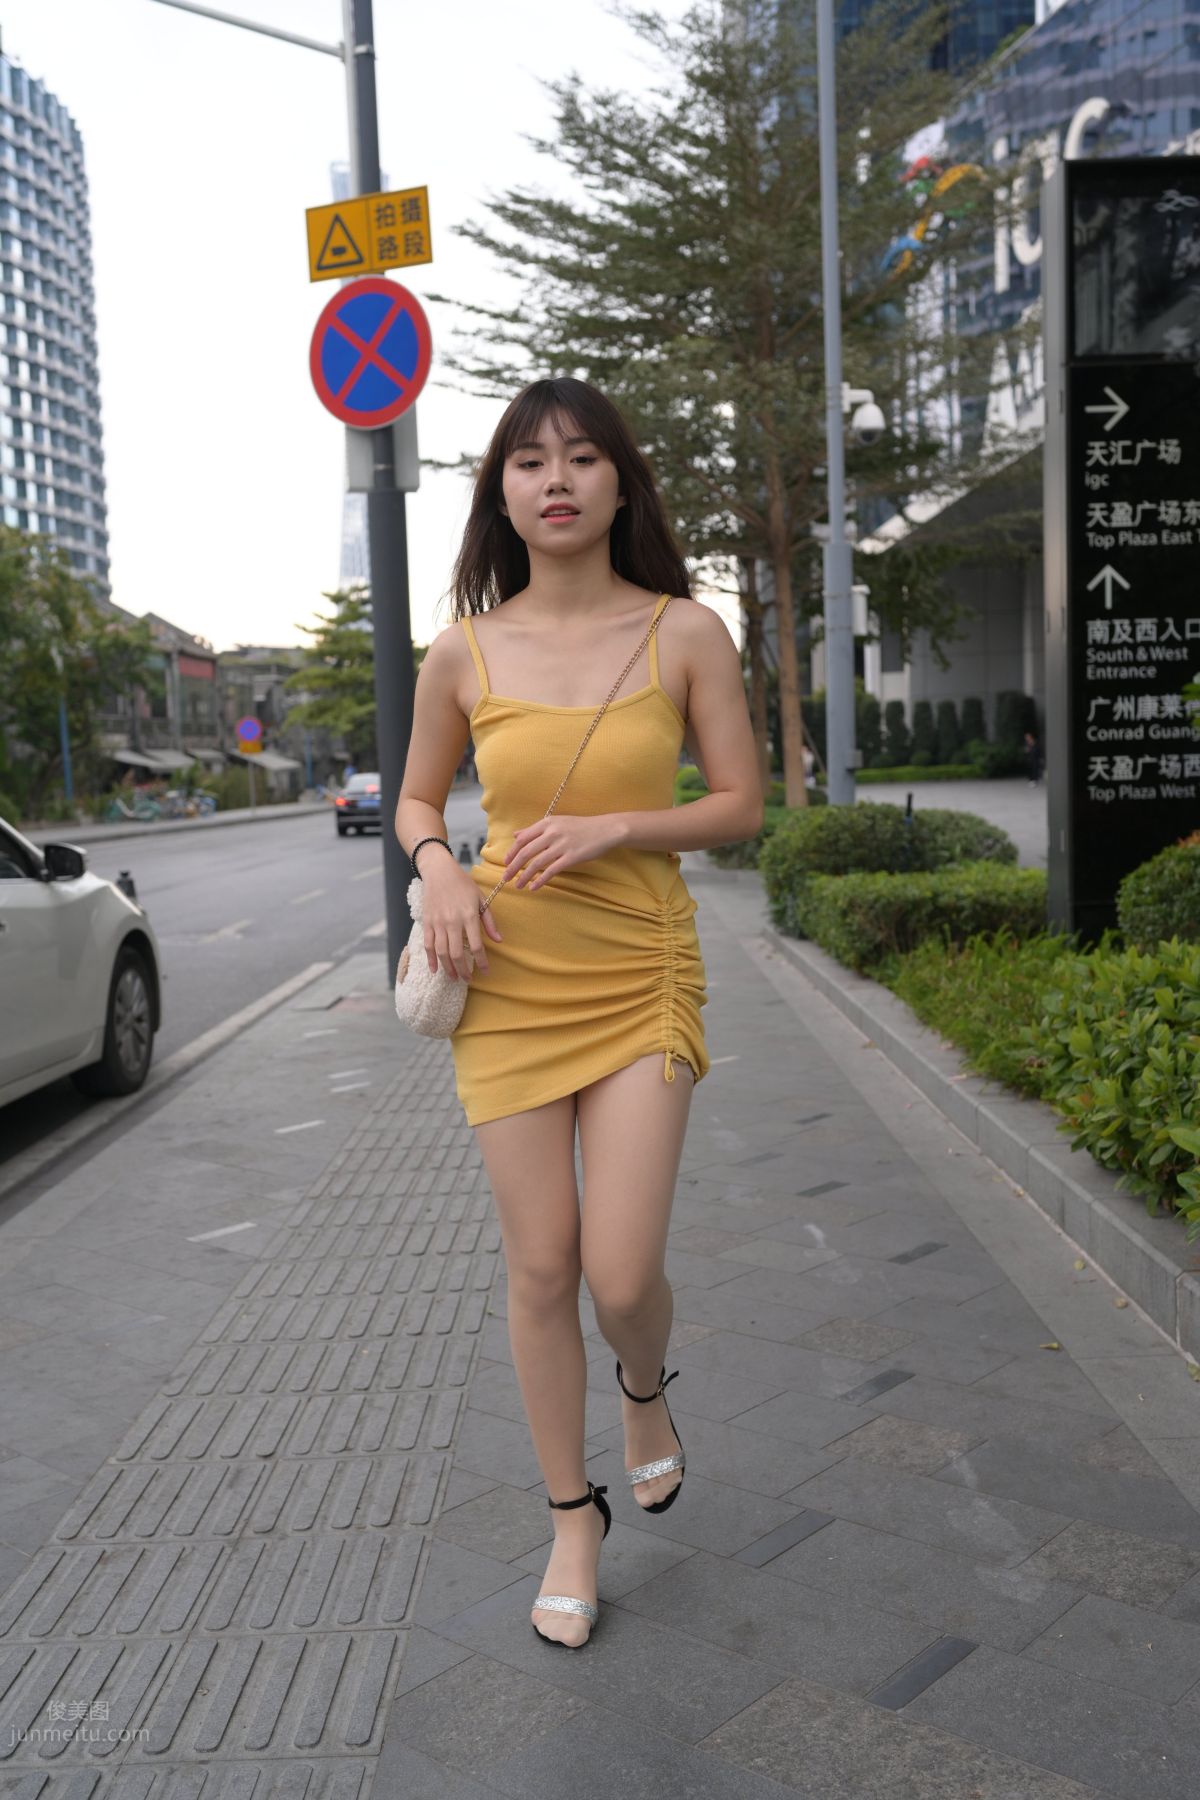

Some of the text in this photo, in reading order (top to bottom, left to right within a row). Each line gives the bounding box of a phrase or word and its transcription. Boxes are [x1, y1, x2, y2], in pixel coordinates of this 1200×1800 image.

[377, 230, 424, 260] 路段
[1086, 439, 1182, 467] 天汇广场
[1085, 472, 1109, 490] igc
[1086, 532, 1115, 549] Top
[1119, 530, 1158, 546] Plaza
[1161, 529, 1193, 545] East
[1086, 617, 1200, 645] 南及西入口
[1086, 646, 1188, 663] South & West
[1086, 664, 1157, 680] Entrance
[1086, 724, 1144, 741] Conrad
[1087, 753, 1200, 781] 天盈广场西
[1088, 782, 1196, 803] Top Plaza West
